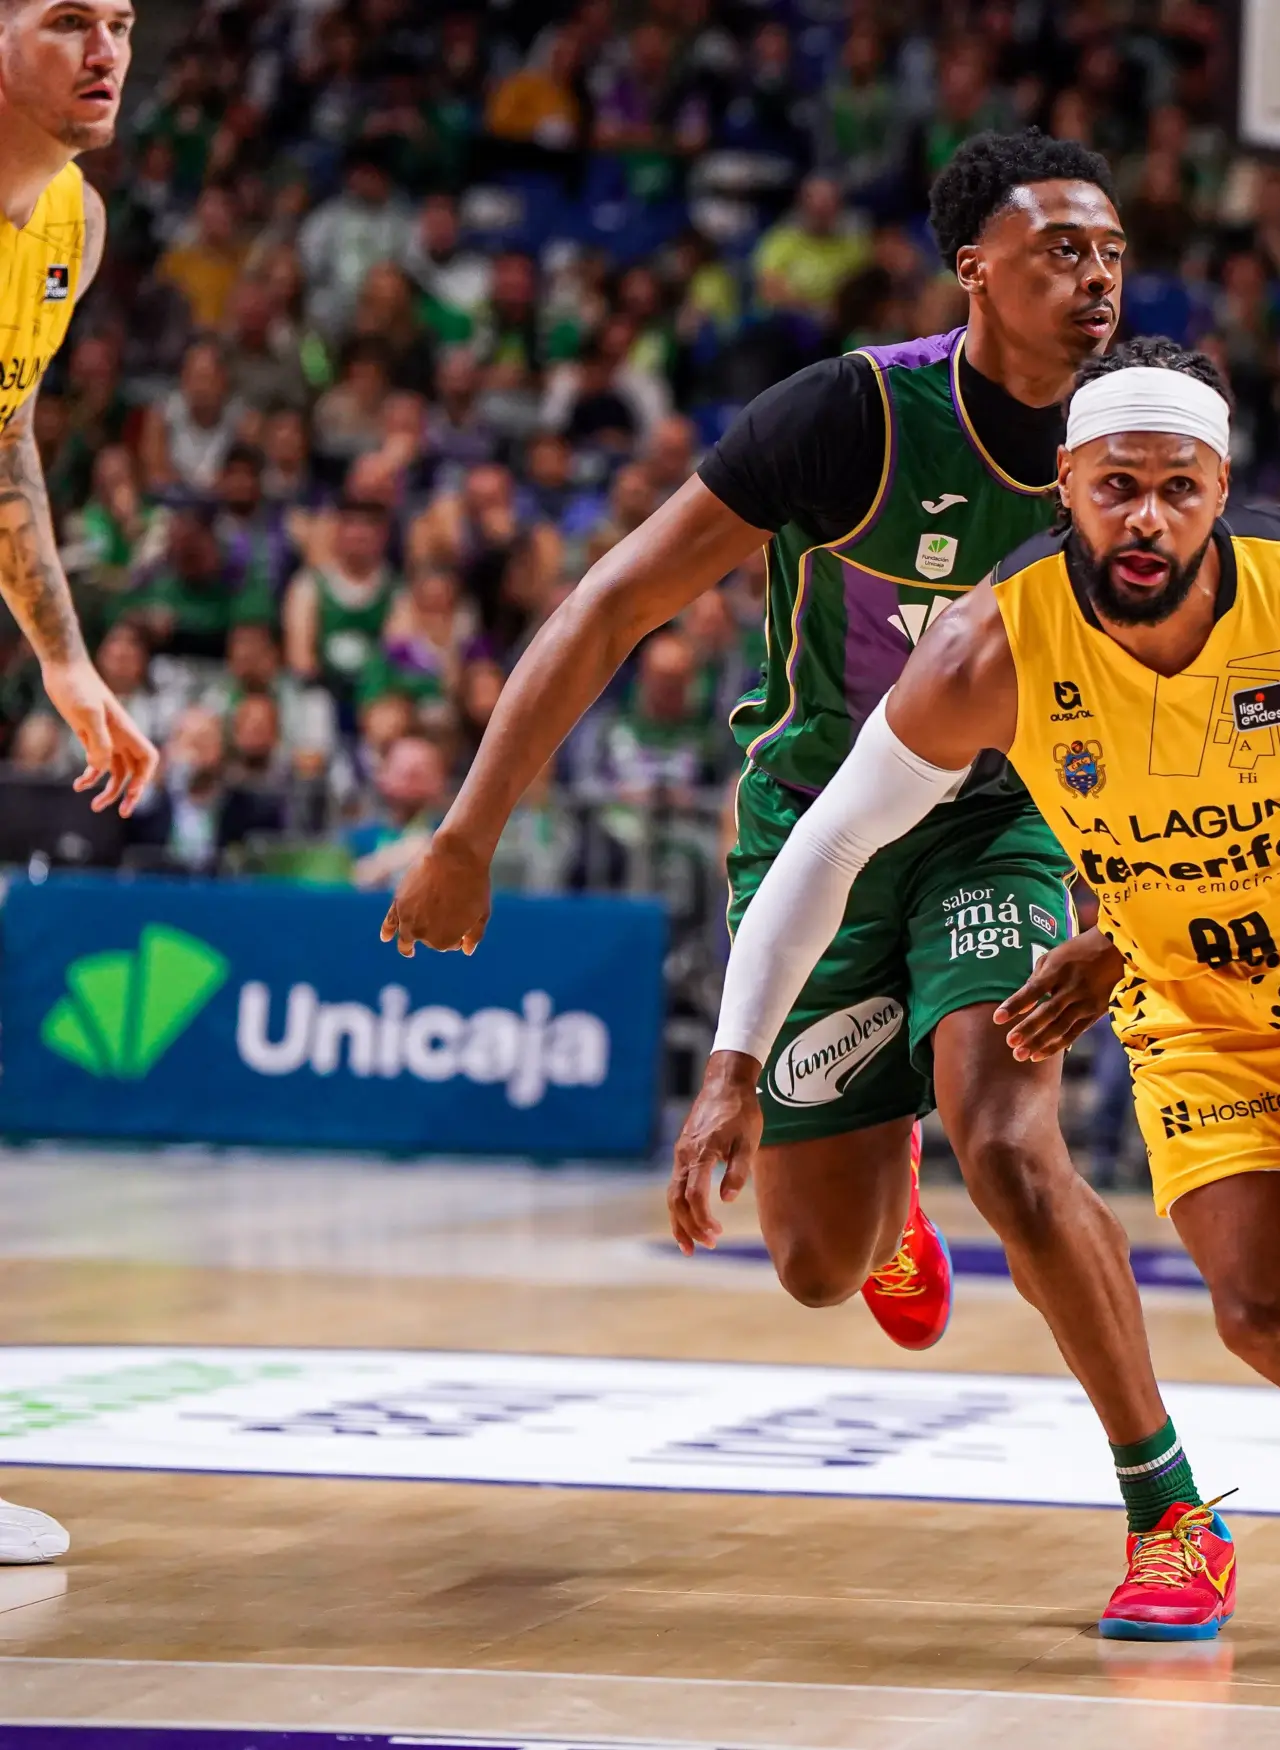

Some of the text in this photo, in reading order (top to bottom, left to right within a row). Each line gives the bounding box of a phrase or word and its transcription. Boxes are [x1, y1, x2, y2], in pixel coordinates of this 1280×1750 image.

[1239, 702, 1264, 715] liga
[1239, 740, 1252, 751] A
[1238, 772, 1258, 784] Hi
[1060, 806, 1122, 846] LA
[942, 888, 994, 912] sabor
[1094, 878, 1186, 904] espierta
[944, 893, 1024, 932] a má
[1033, 913, 1052, 931] acb
[949, 926, 1024, 961] laga
[237, 980, 610, 1108] Unicaja
[786, 1003, 899, 1097] famadesa
